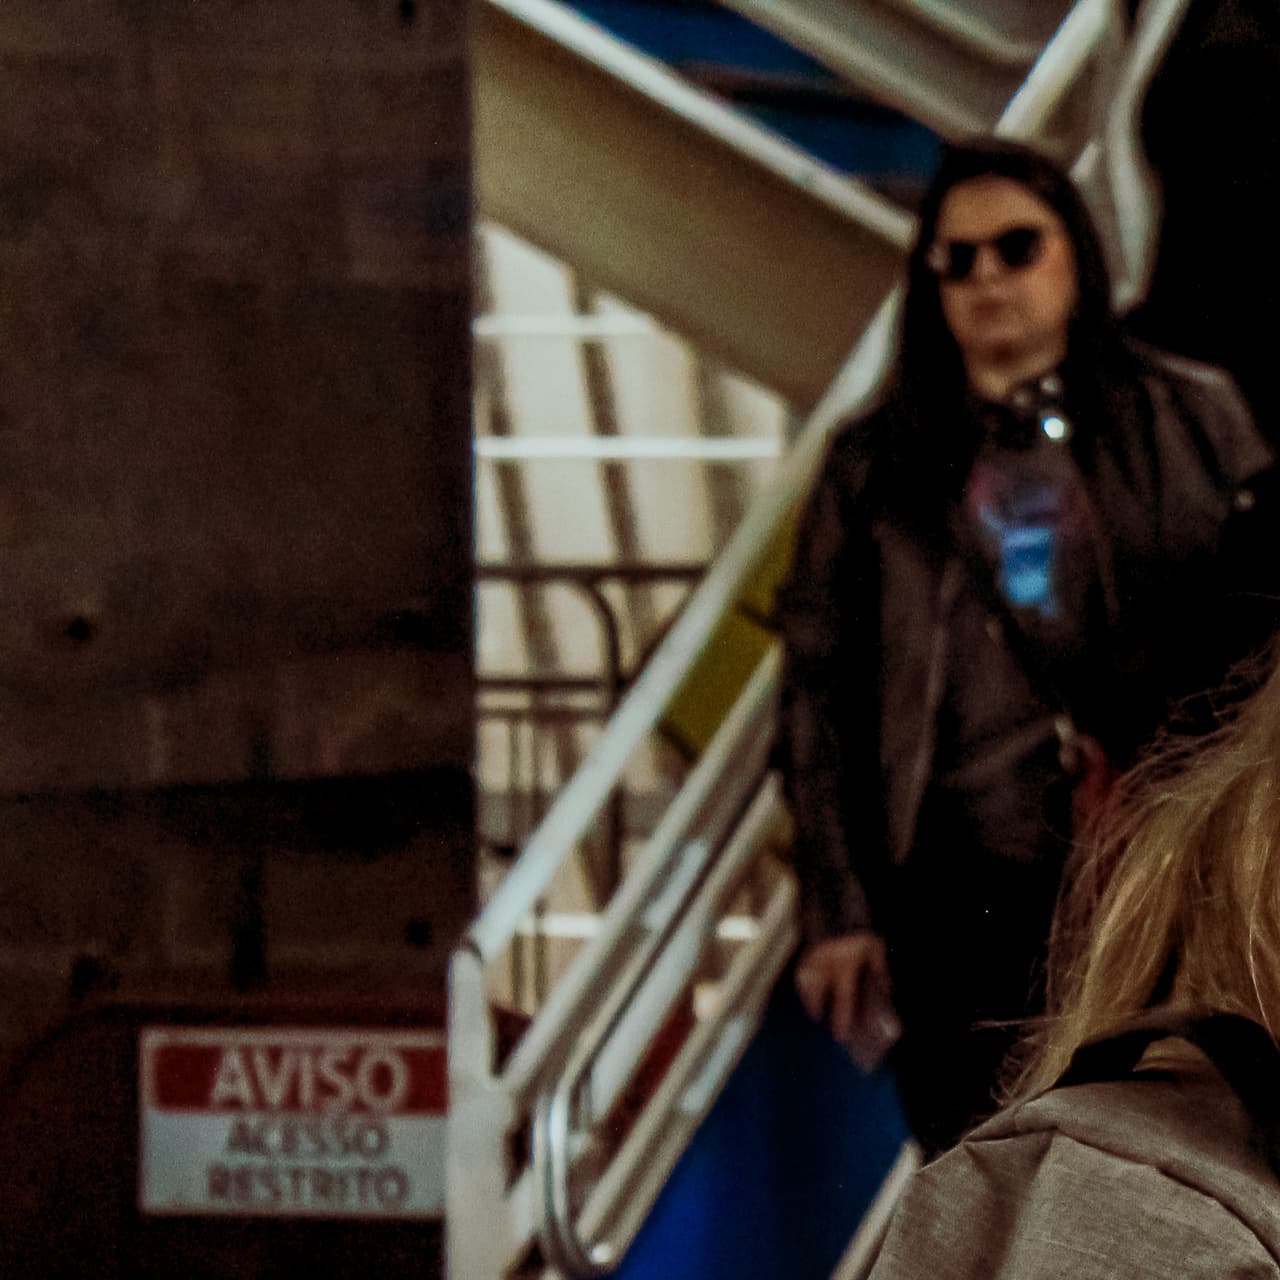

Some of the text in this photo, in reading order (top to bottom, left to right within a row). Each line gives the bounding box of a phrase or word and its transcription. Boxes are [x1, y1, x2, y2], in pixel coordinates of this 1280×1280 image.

[210, 1047, 408, 1111] AVISO
[226, 1118, 391, 1157] ACESSO
[207, 1164, 410, 1202] RESTRITO
